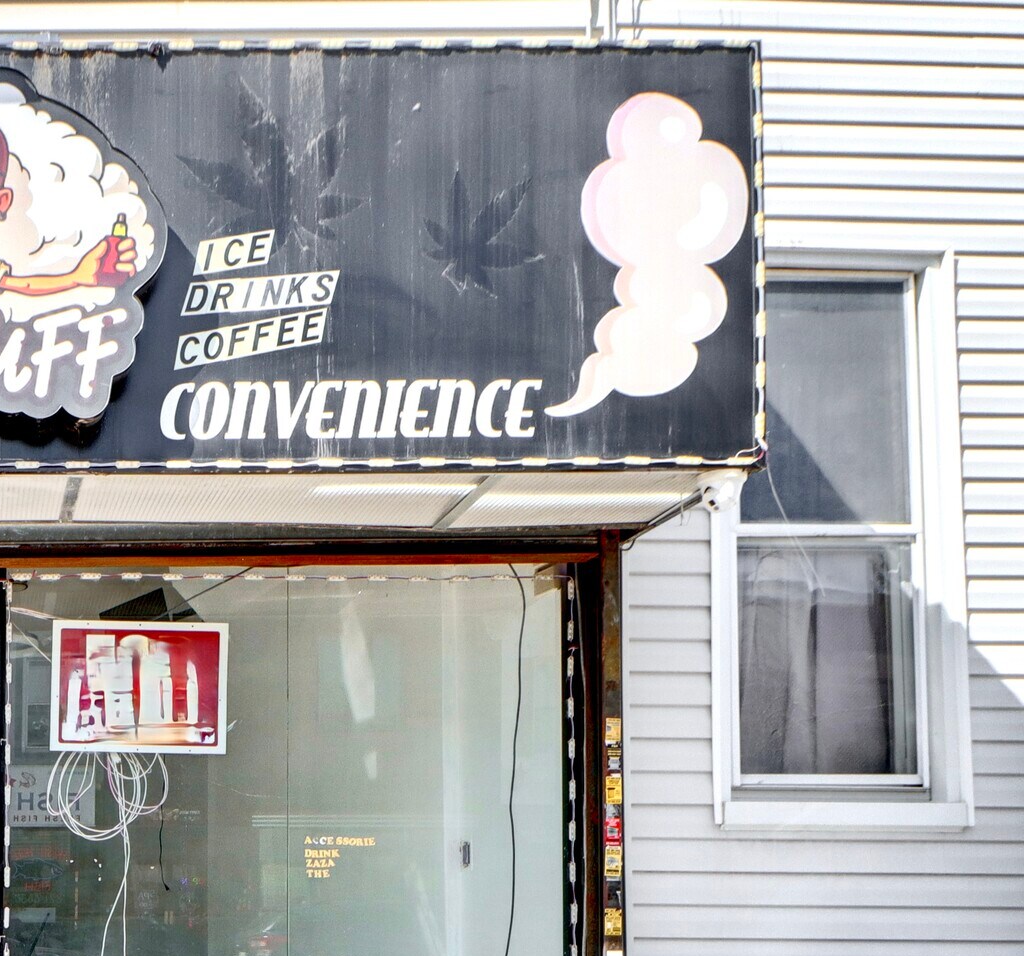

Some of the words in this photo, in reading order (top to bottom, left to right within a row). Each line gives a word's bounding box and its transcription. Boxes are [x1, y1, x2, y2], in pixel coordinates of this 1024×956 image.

[204, 236, 268, 269] ICE
[187, 271, 332, 314] DRINKS
[180, 311, 322, 366] COFFEE
[160, 378, 543, 441] CONVENIENCE
[304, 848, 340, 859] DRINK
[305, 858, 336, 869] ZAZA
[306, 869, 331, 879] THE
